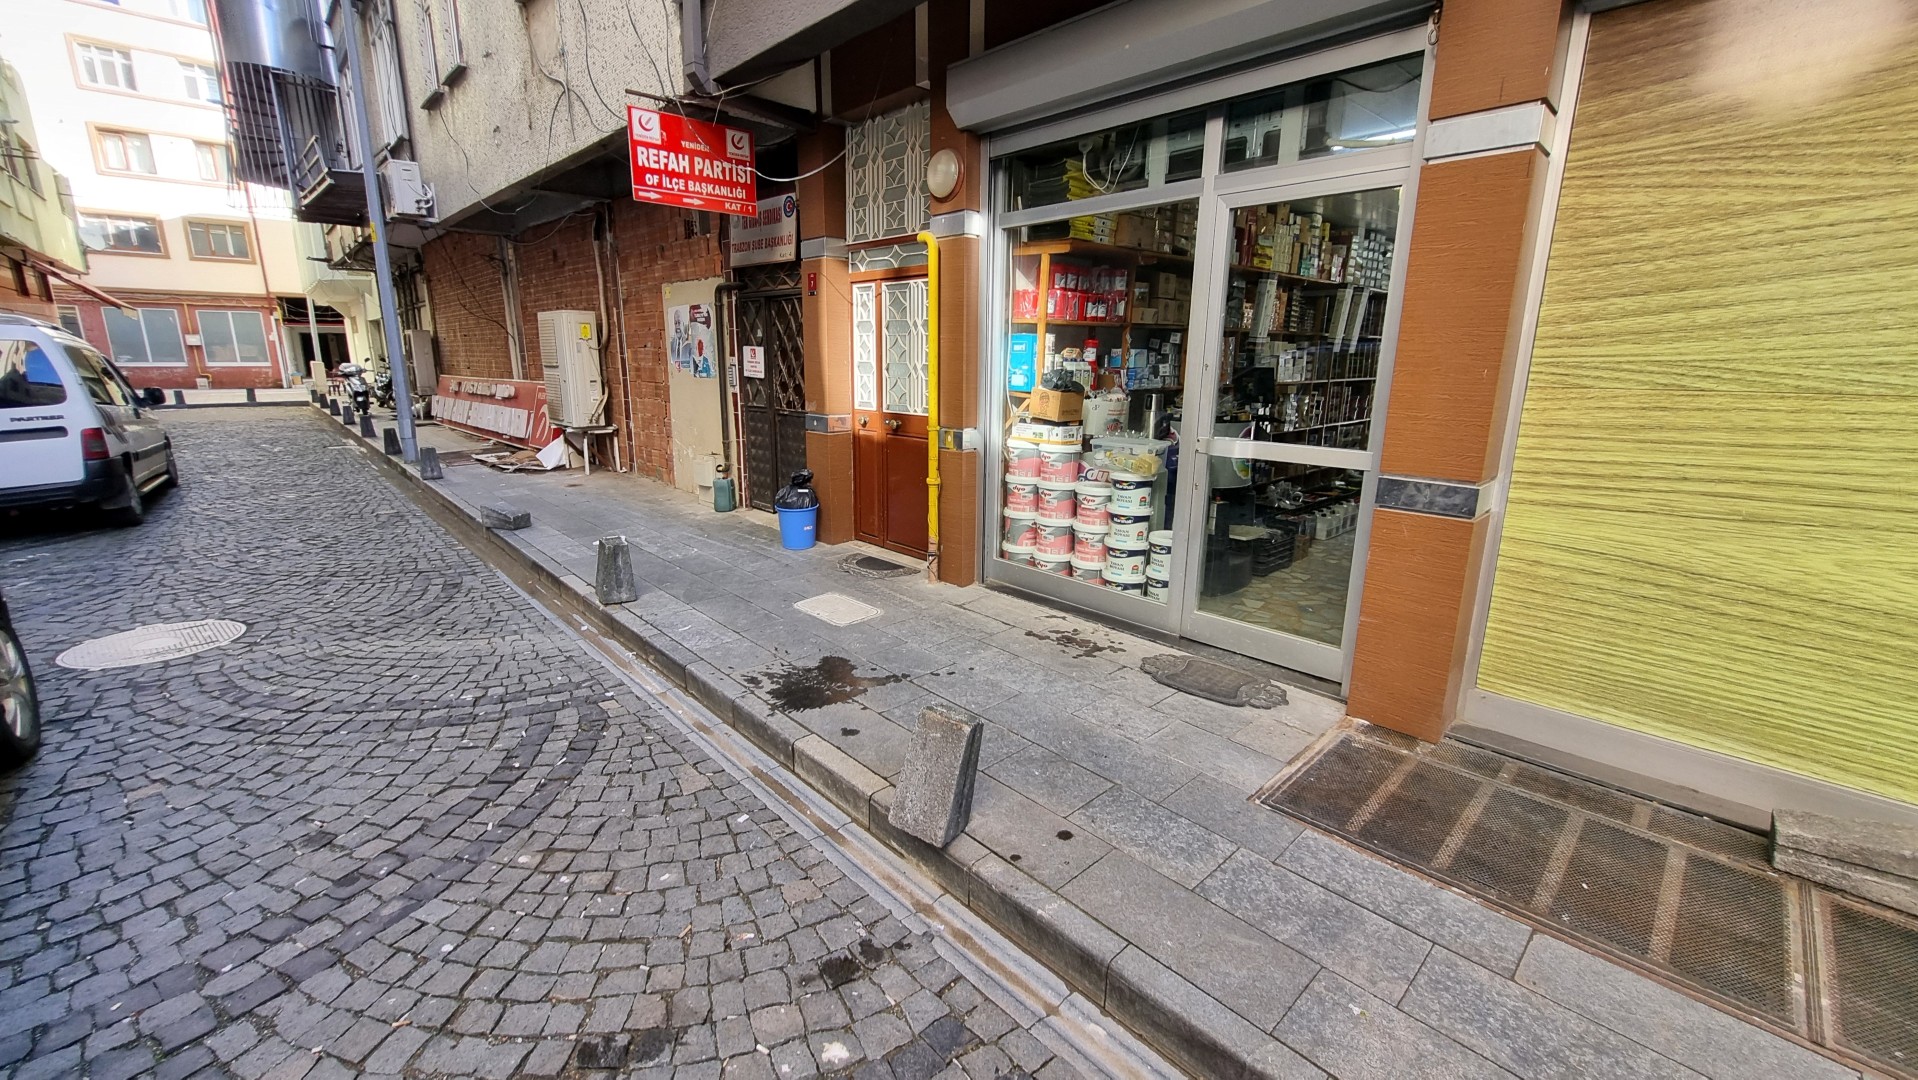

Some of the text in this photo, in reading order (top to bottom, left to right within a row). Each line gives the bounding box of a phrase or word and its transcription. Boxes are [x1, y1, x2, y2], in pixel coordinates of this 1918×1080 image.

[681, 140, 710, 152] YENİDEN
[637, 145, 751, 184] REFAH PARTİSİ
[645, 173, 746, 199] OF İLÇE BAŞKANLIĞI
[724, 202, 741, 211] KAT
[748, 205, 752, 213] 1
[765, 231, 794, 251] BAŞKANLIĞI
[1081, 496, 1096, 504] dyo
[1036, 561, 1048, 569] dyo
